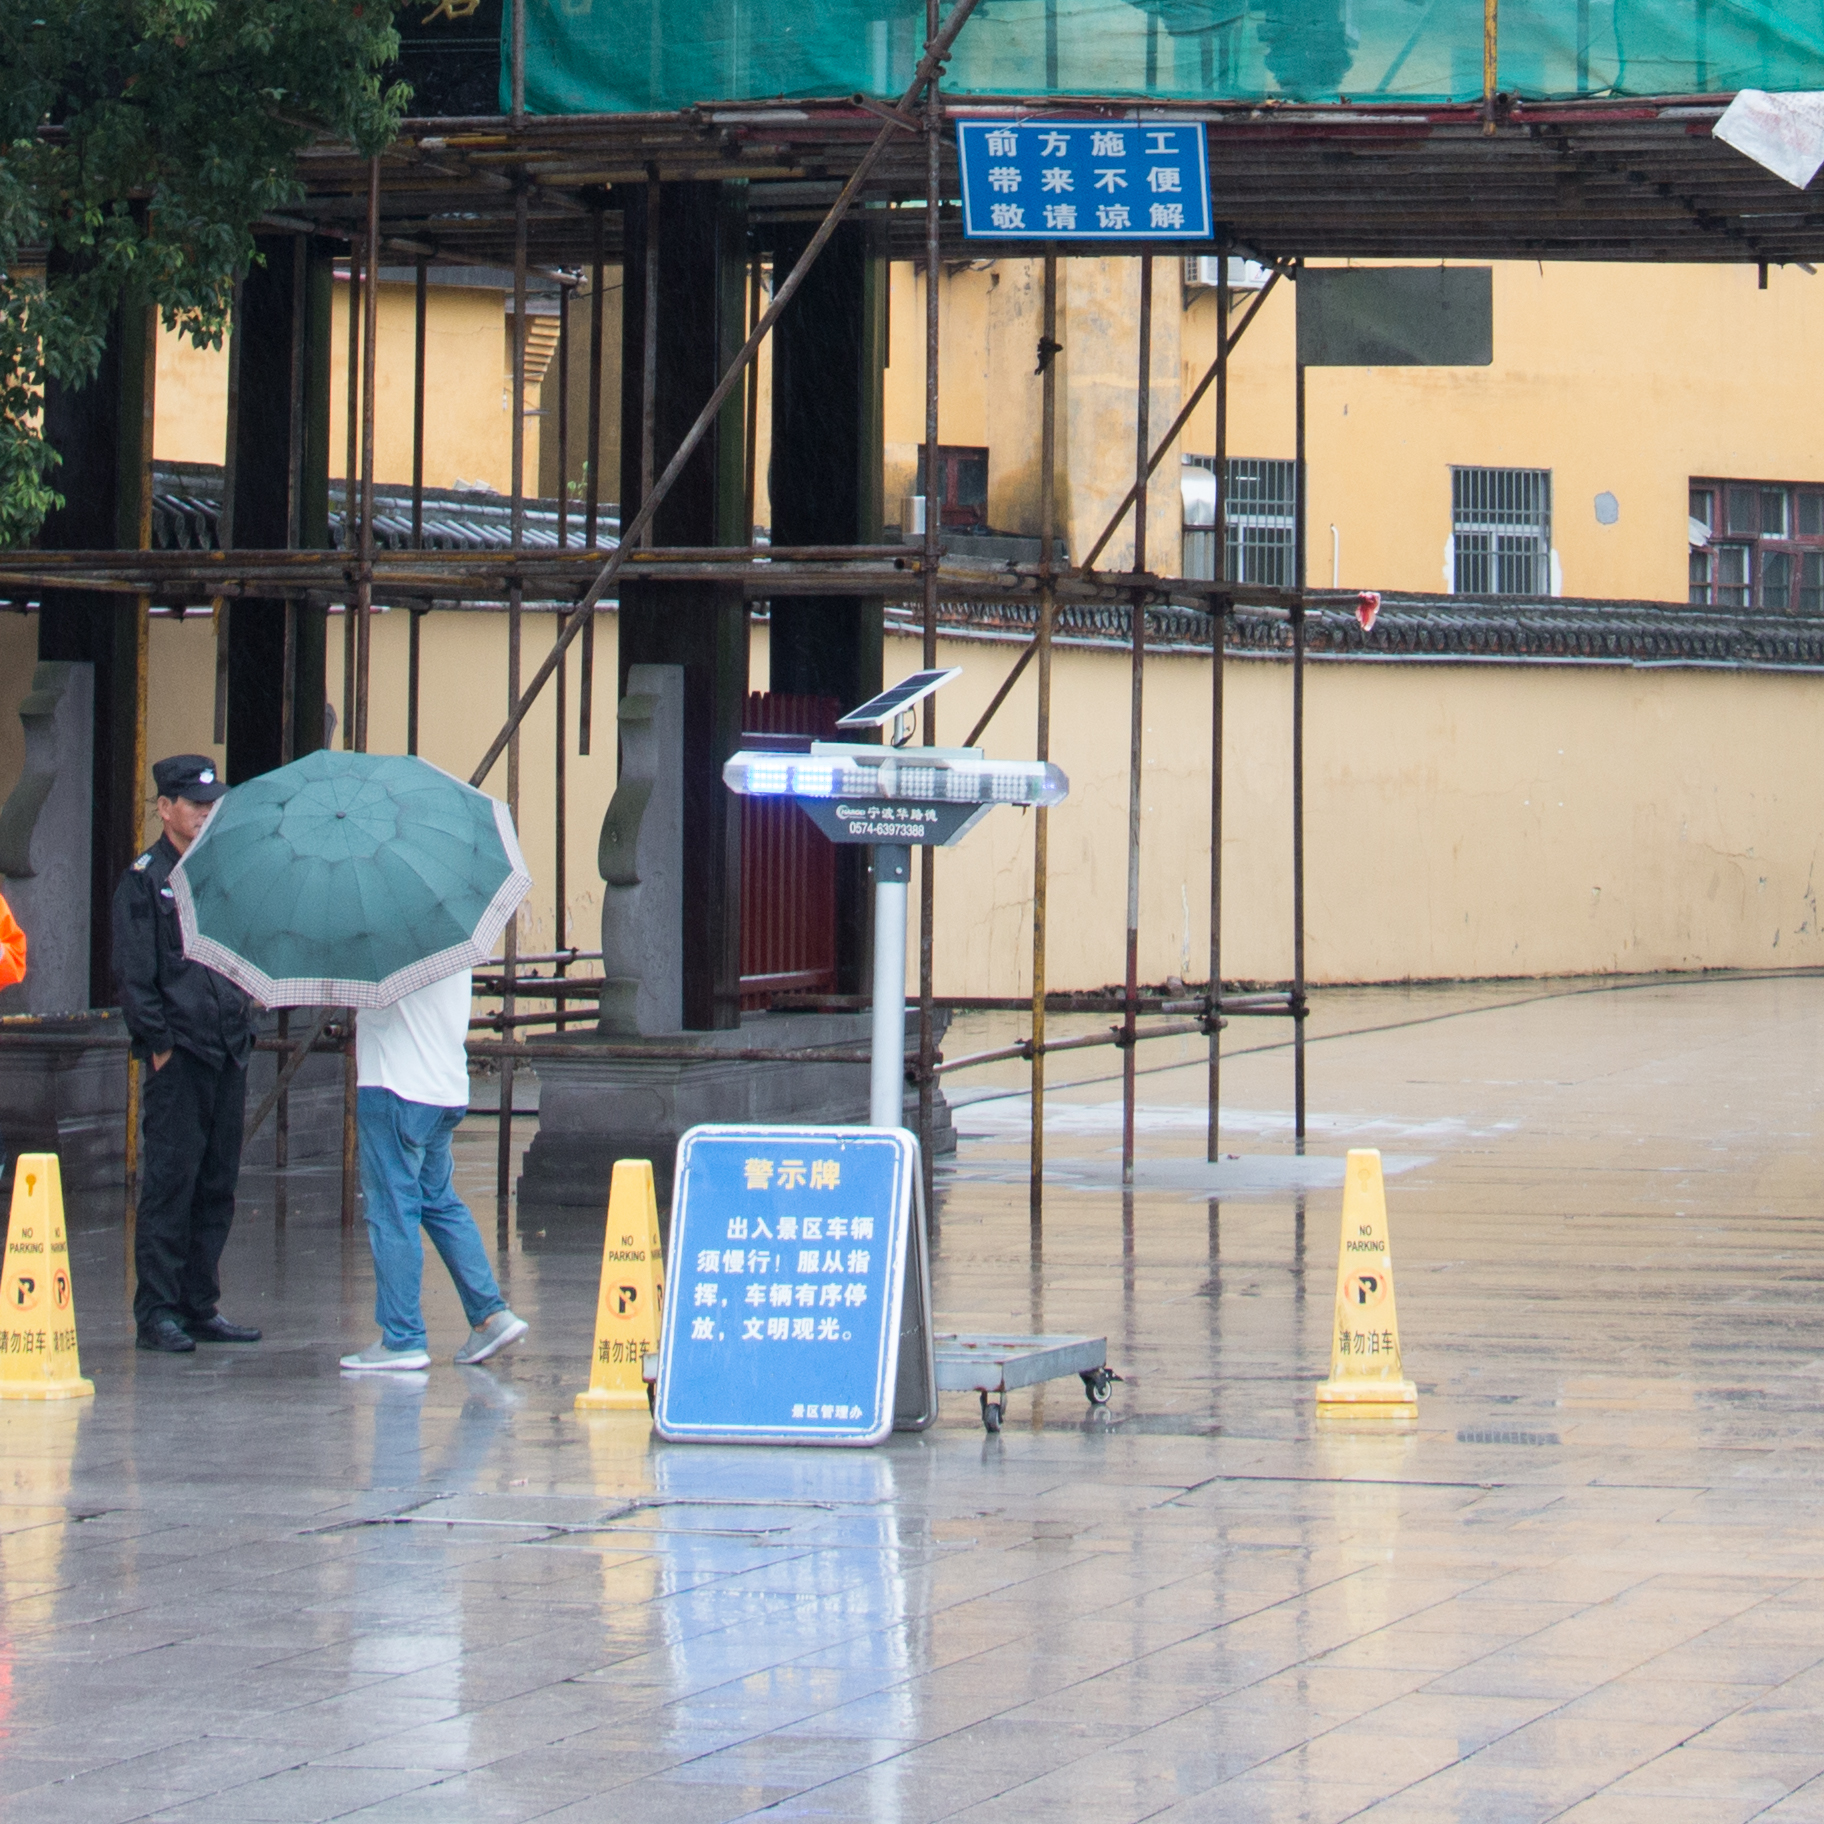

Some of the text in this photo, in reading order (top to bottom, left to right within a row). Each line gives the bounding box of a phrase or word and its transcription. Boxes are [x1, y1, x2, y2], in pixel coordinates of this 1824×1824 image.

[984, 130, 1179, 158] 前方施工
[988, 166, 1182, 194] 带来不便
[990, 203, 1185, 230] 敬请谅解
[744, 1157, 841, 1190] 警示牌
[22, 1227, 33, 1238] NO
[727, 1216, 874, 1240] 出入景区车辆
[1359, 1225, 1372, 1236] NO
[9, 1242, 44, 1254] PARKING
[621, 1235, 633, 1246] NO
[1346, 1240, 1385, 1252] PARKING
[609, 1250, 646, 1262] PARKING
[598, 1338, 650, 1364] 请勿泊车
[1339, 1329, 1394, 1355] 请勿泊车
[791, 1403, 864, 1420] 景区管理办
